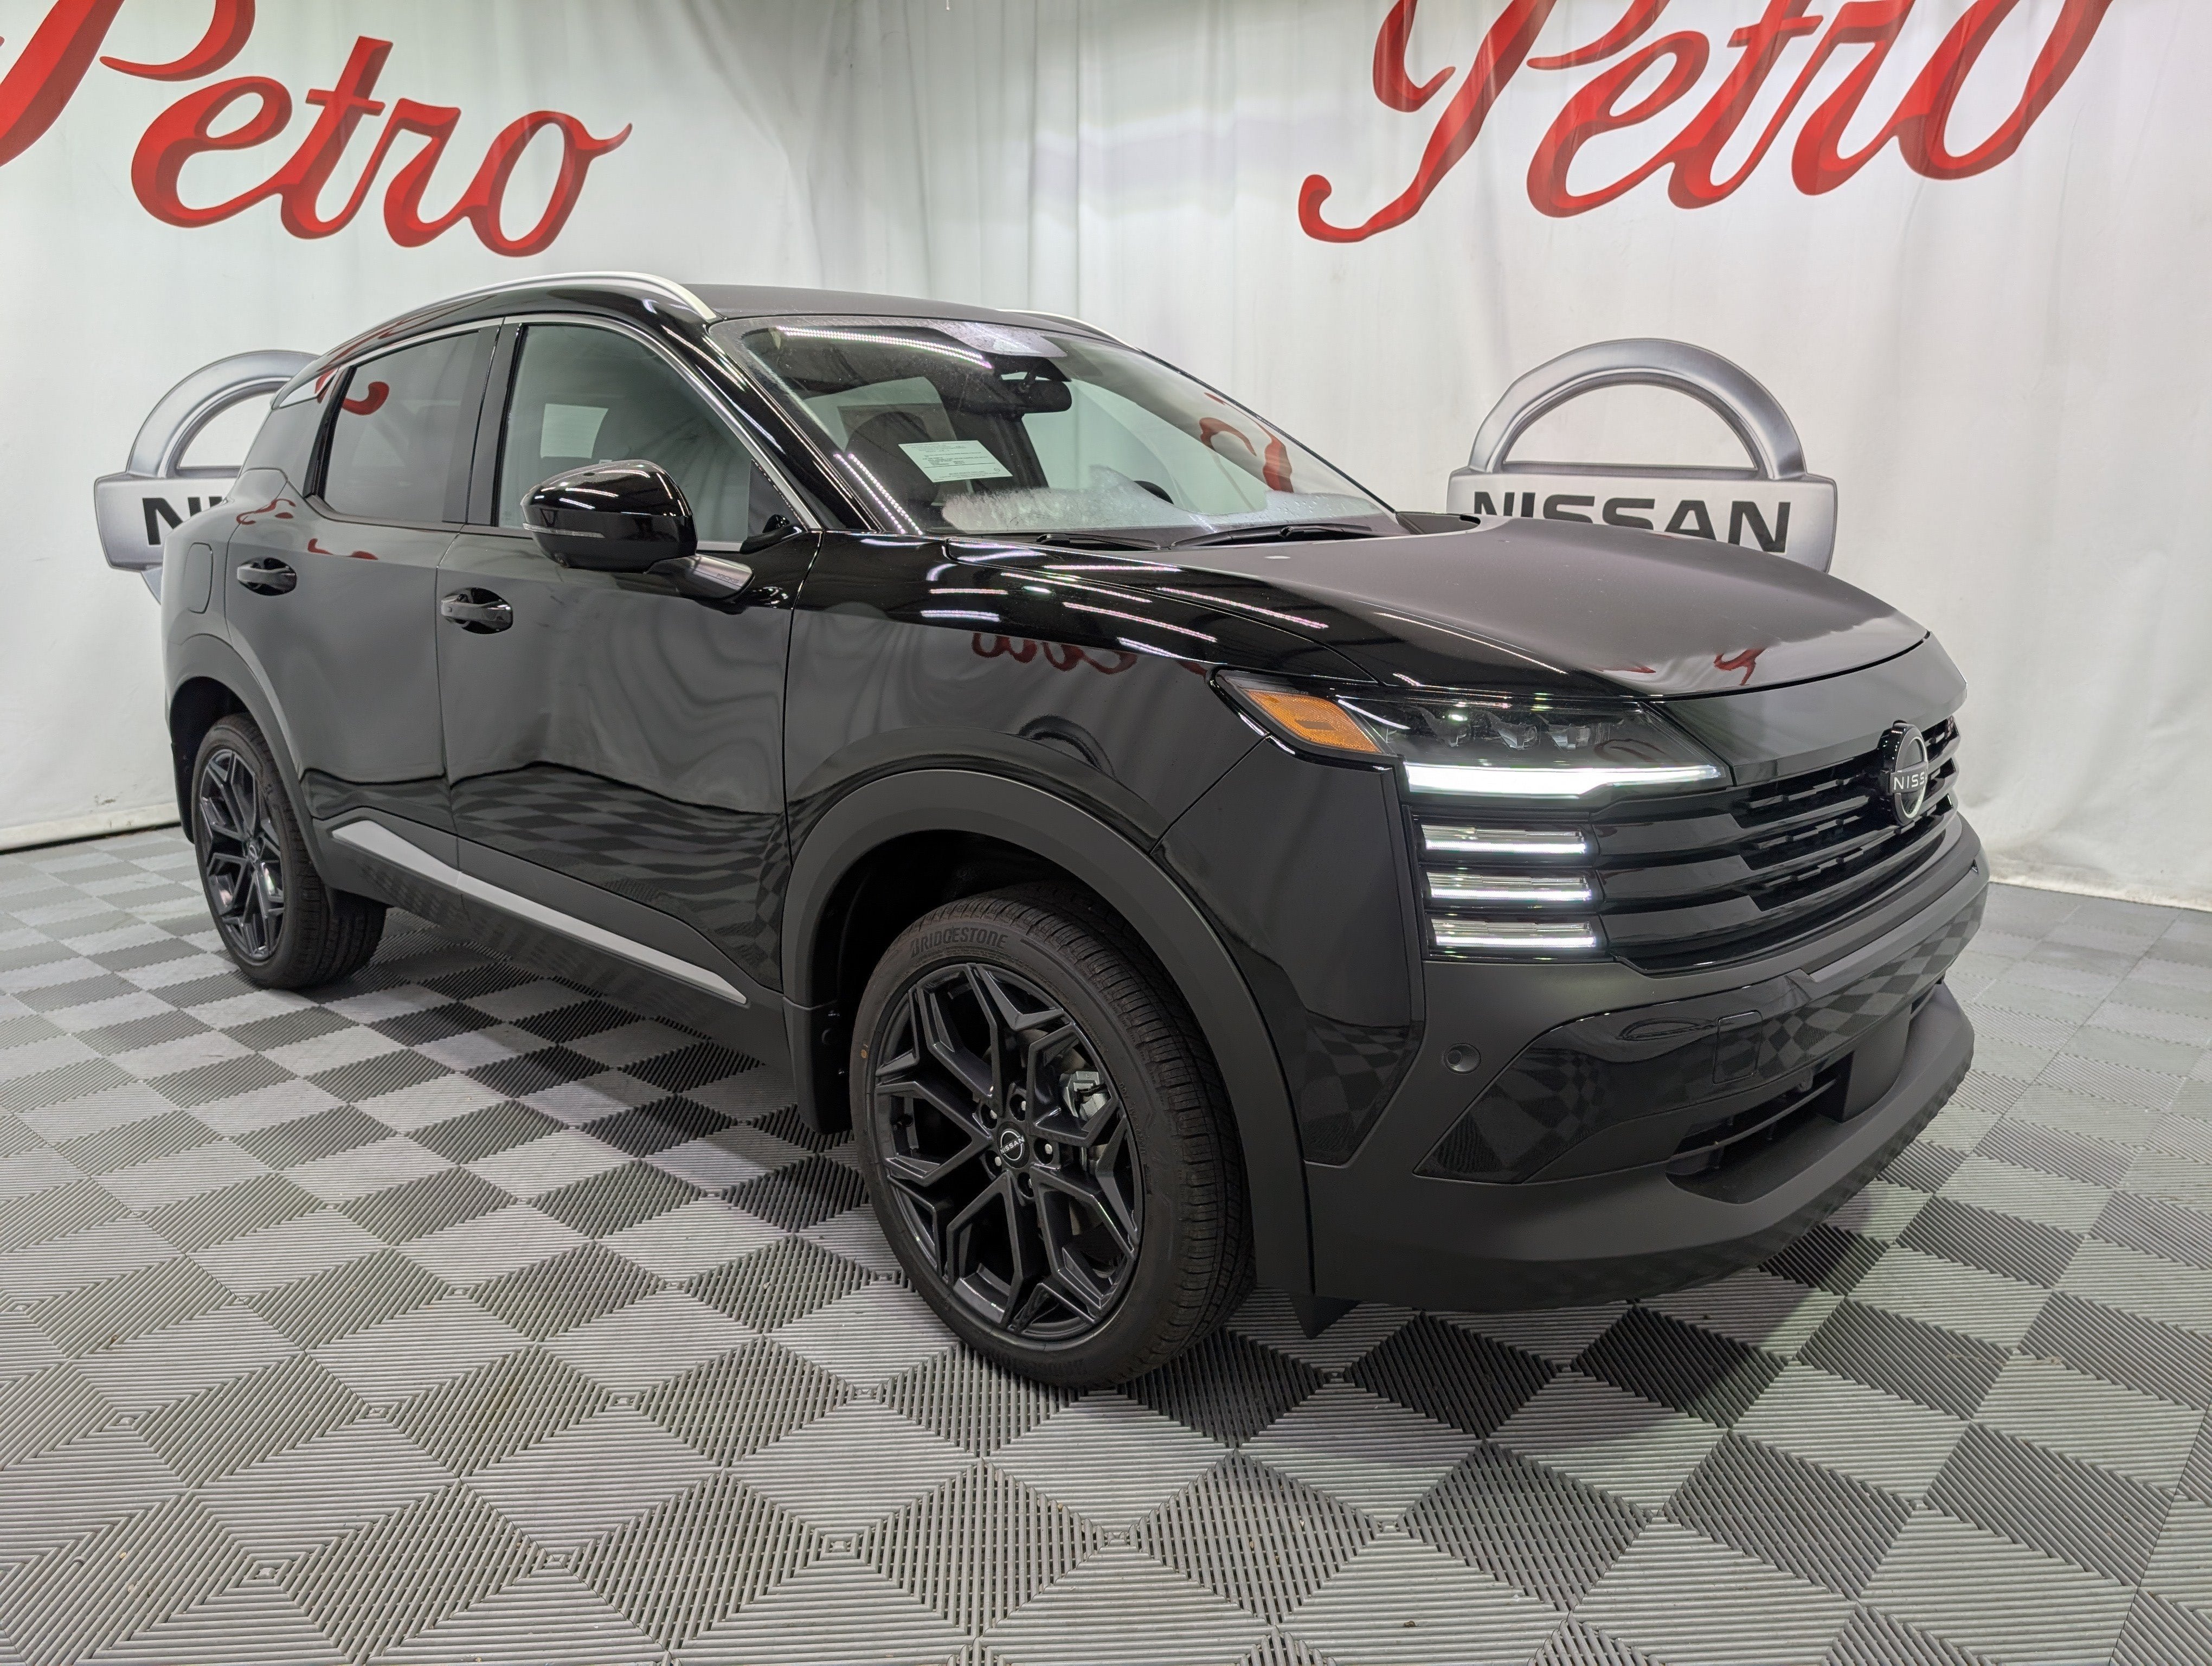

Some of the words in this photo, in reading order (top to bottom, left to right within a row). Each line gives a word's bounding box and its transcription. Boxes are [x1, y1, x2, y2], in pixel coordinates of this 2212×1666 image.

[1893, 771, 1927, 791] NISS
[910, 927, 1008, 958] BRIDGESTONE
[1000, 1135, 1026, 1155] NISSAN
